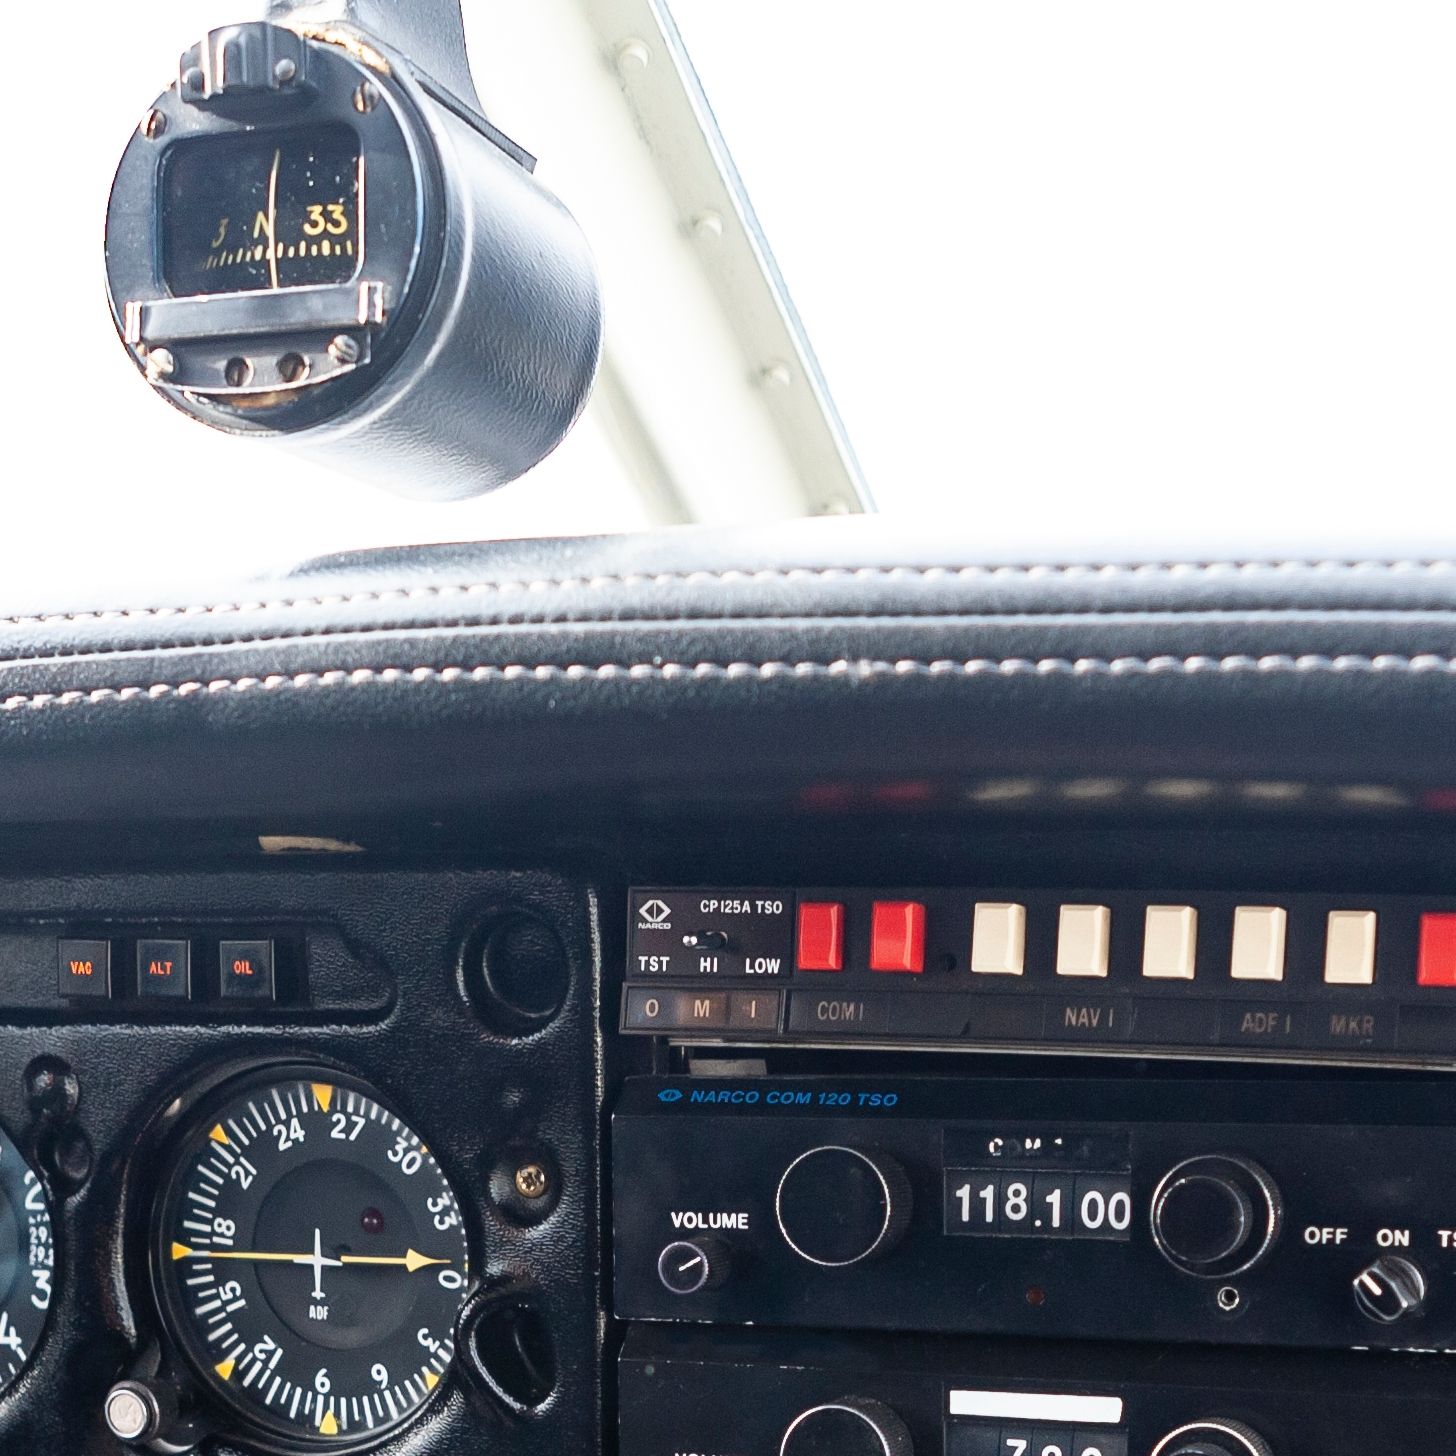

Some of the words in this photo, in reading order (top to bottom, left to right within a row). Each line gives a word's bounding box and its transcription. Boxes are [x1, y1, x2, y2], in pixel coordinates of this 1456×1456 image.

[304, 203, 347, 236] 33
[756, 901, 783, 915] TSO
[638, 922, 671, 930] NARCO
[150, 961, 172, 975] ALT
[233, 961, 253, 975] OIL
[638, 956, 670, 973] TST
[700, 957, 718, 973] HI
[745, 958, 780, 974] LOW
[645, 999, 659, 1017] O
[694, 999, 710, 1018] M
[1064, 1006, 1100, 1028] NAV
[1240, 1012, 1279, 1034] ADF
[1330, 1014, 1375, 1037] MKR
[690, 1090, 759, 1105] NARCO
[766, 1091, 810, 1106] COM
[818, 1092, 851, 1106] 120
[857, 1092, 898, 1107] TSO
[272, 1116, 306, 1152] 24
[331, 1112, 366, 1143] 27
[387, 1139, 423, 1176] 30
[230, 1156, 258, 1190] 21
[24, 1170, 46, 1211] 2
[426, 1196, 457, 1232] 33
[671, 1211, 749, 1230] VOLUME
[212, 1218, 236, 1247] 18
[1304, 1226, 1348, 1247] OFF
[1376, 1228, 1410, 1247] ON
[31, 1269, 52, 1310] 3
[438, 1268, 462, 1290] 0
[217, 1279, 246, 1312] 15
[309, 1304, 329, 1321] ADF
[417, 1327, 440, 1350] 3
[252, 1335, 284, 1370] 12
